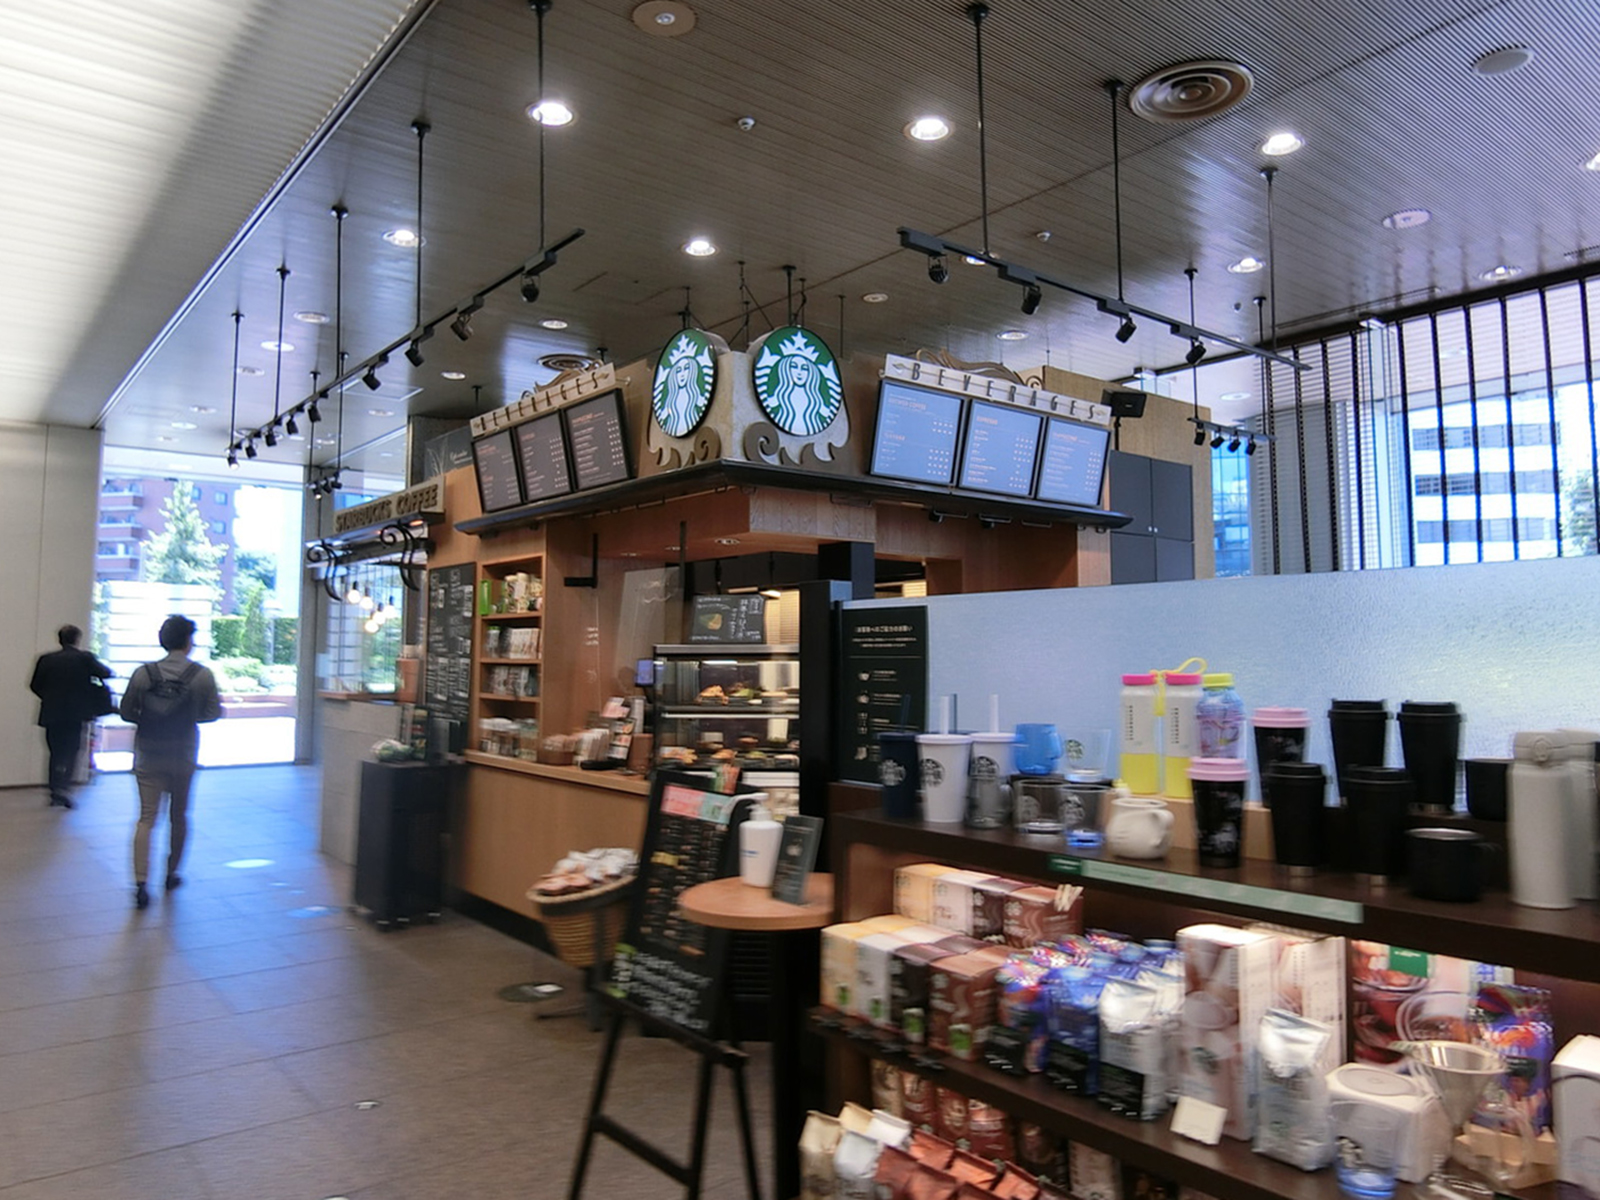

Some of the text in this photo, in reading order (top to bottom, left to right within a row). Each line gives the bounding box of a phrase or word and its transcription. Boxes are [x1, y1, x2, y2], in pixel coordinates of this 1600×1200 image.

[481, 371, 598, 431] BEVERAGES
[911, 362, 1096, 419] BEVERAGES
[336, 484, 438, 532] STARBUCKS COFFEE
